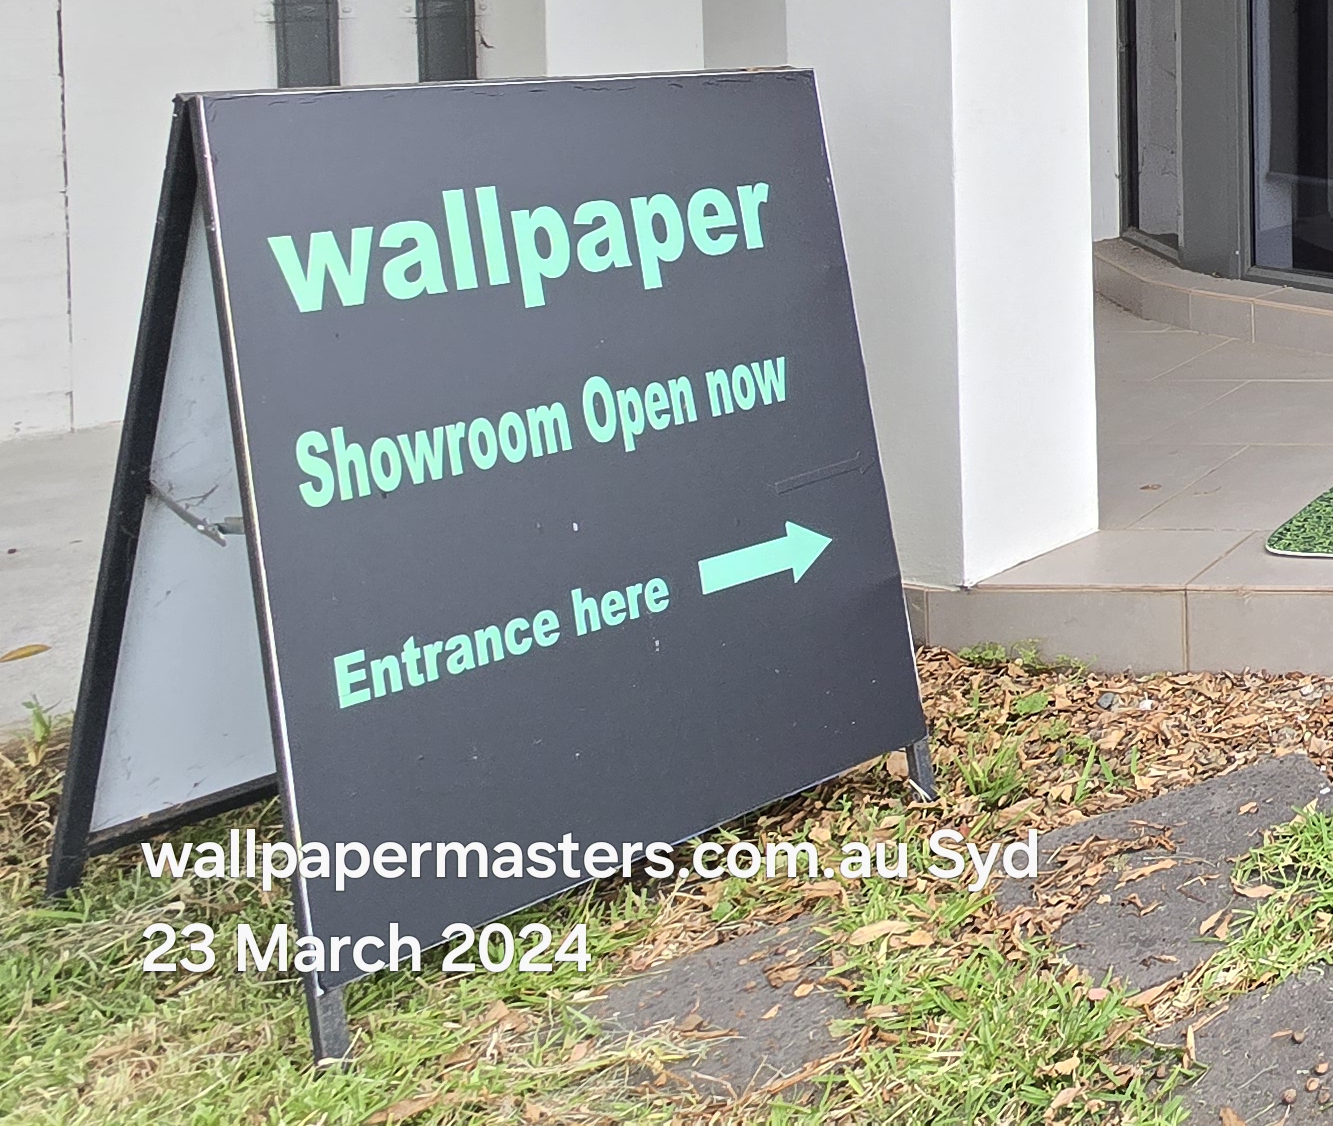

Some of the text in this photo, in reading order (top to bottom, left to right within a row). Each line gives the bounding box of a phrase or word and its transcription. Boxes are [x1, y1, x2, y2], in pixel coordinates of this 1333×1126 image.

[269, 182, 770, 311] wallpaper
[297, 358, 787, 508] Showroom Open now
[334, 578, 670, 708] Entrance here
